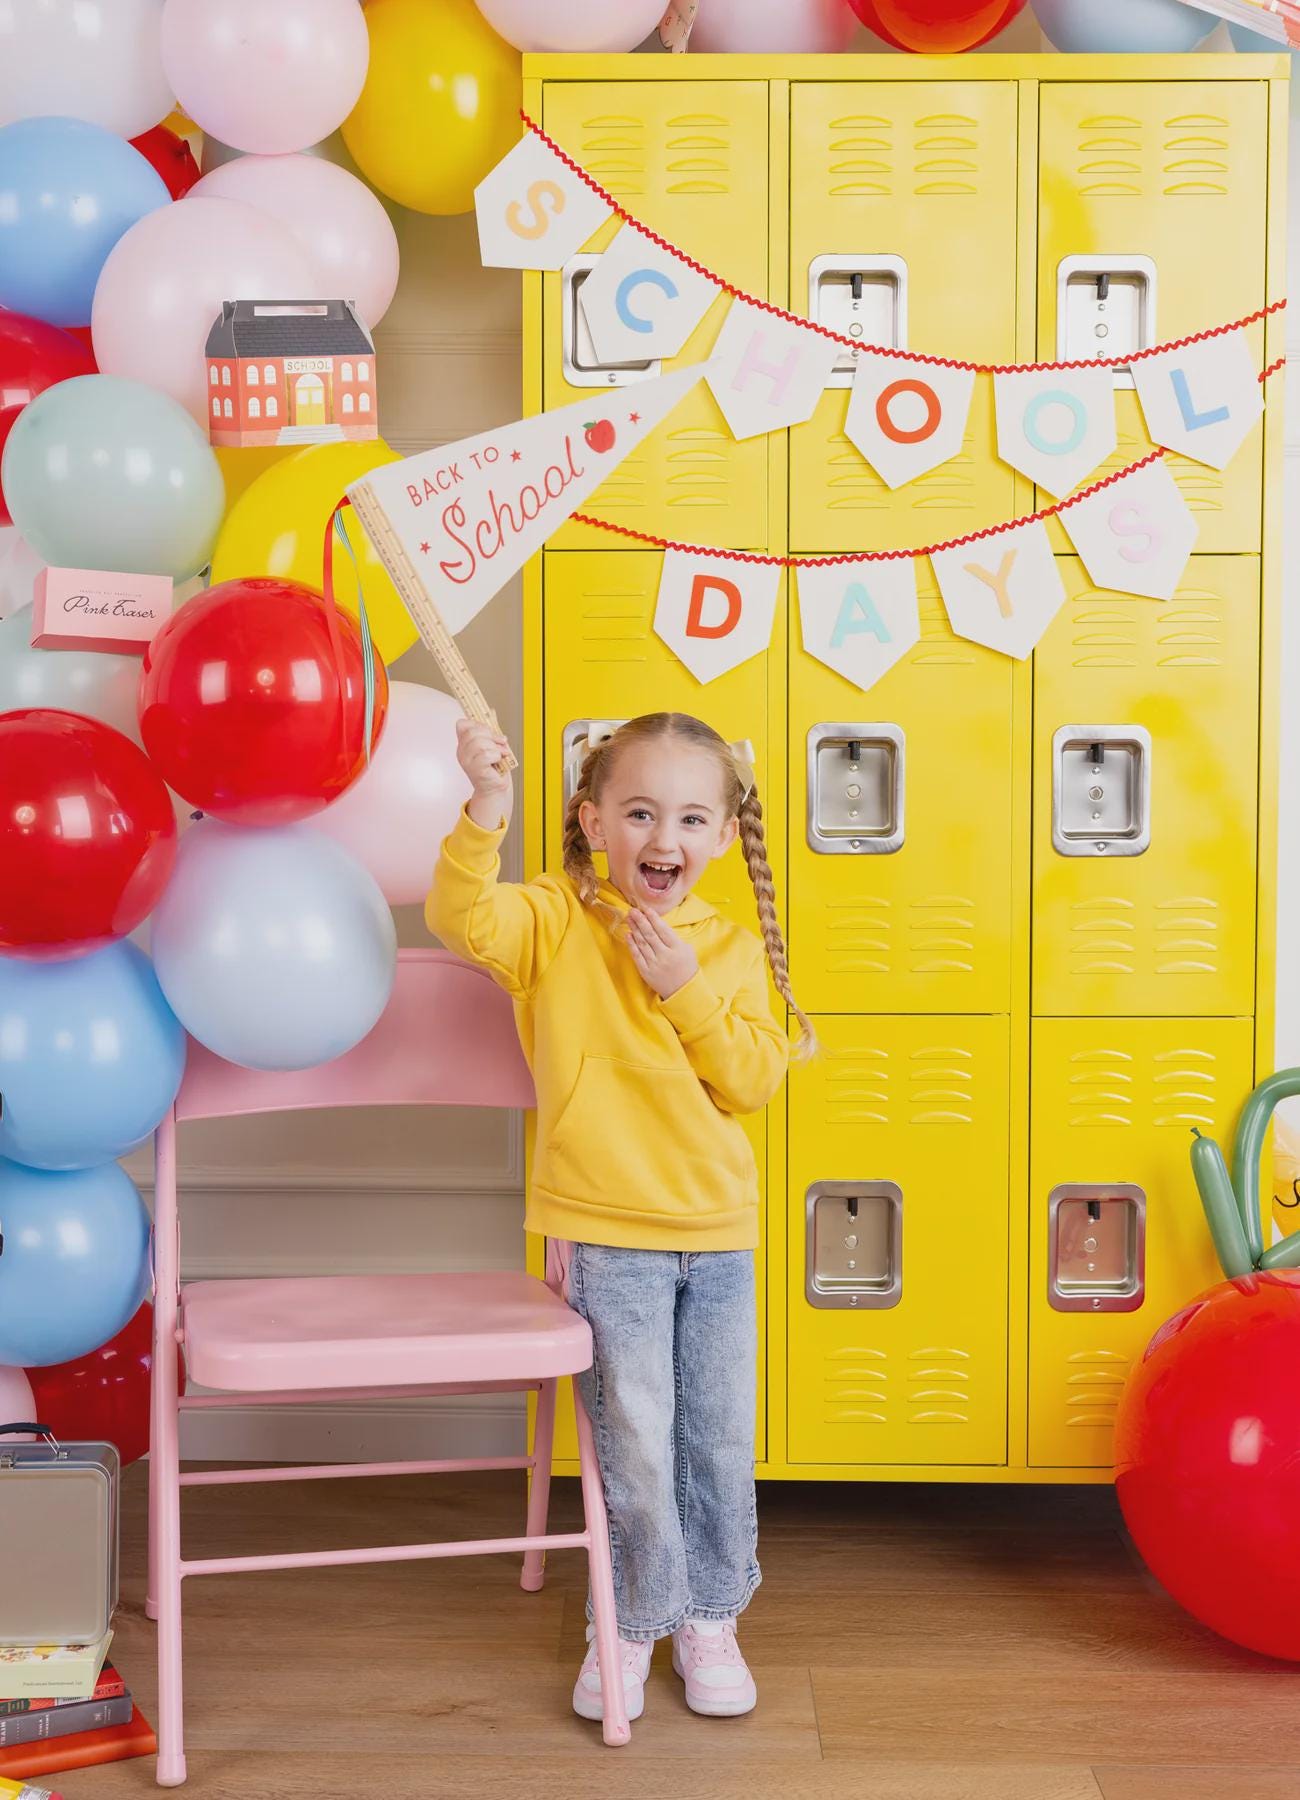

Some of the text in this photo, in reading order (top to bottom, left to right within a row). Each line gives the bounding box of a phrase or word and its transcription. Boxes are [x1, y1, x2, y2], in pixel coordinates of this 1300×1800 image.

[287, 360, 330, 372] SCHOOL
[505, 180, 1231, 456] SCHOOL
[406, 446, 499, 507] BACK TO
[439, 435, 585, 584] School
[63, 595, 157, 619] Pink Eraser
[685, 501, 1162, 649] DAYS
